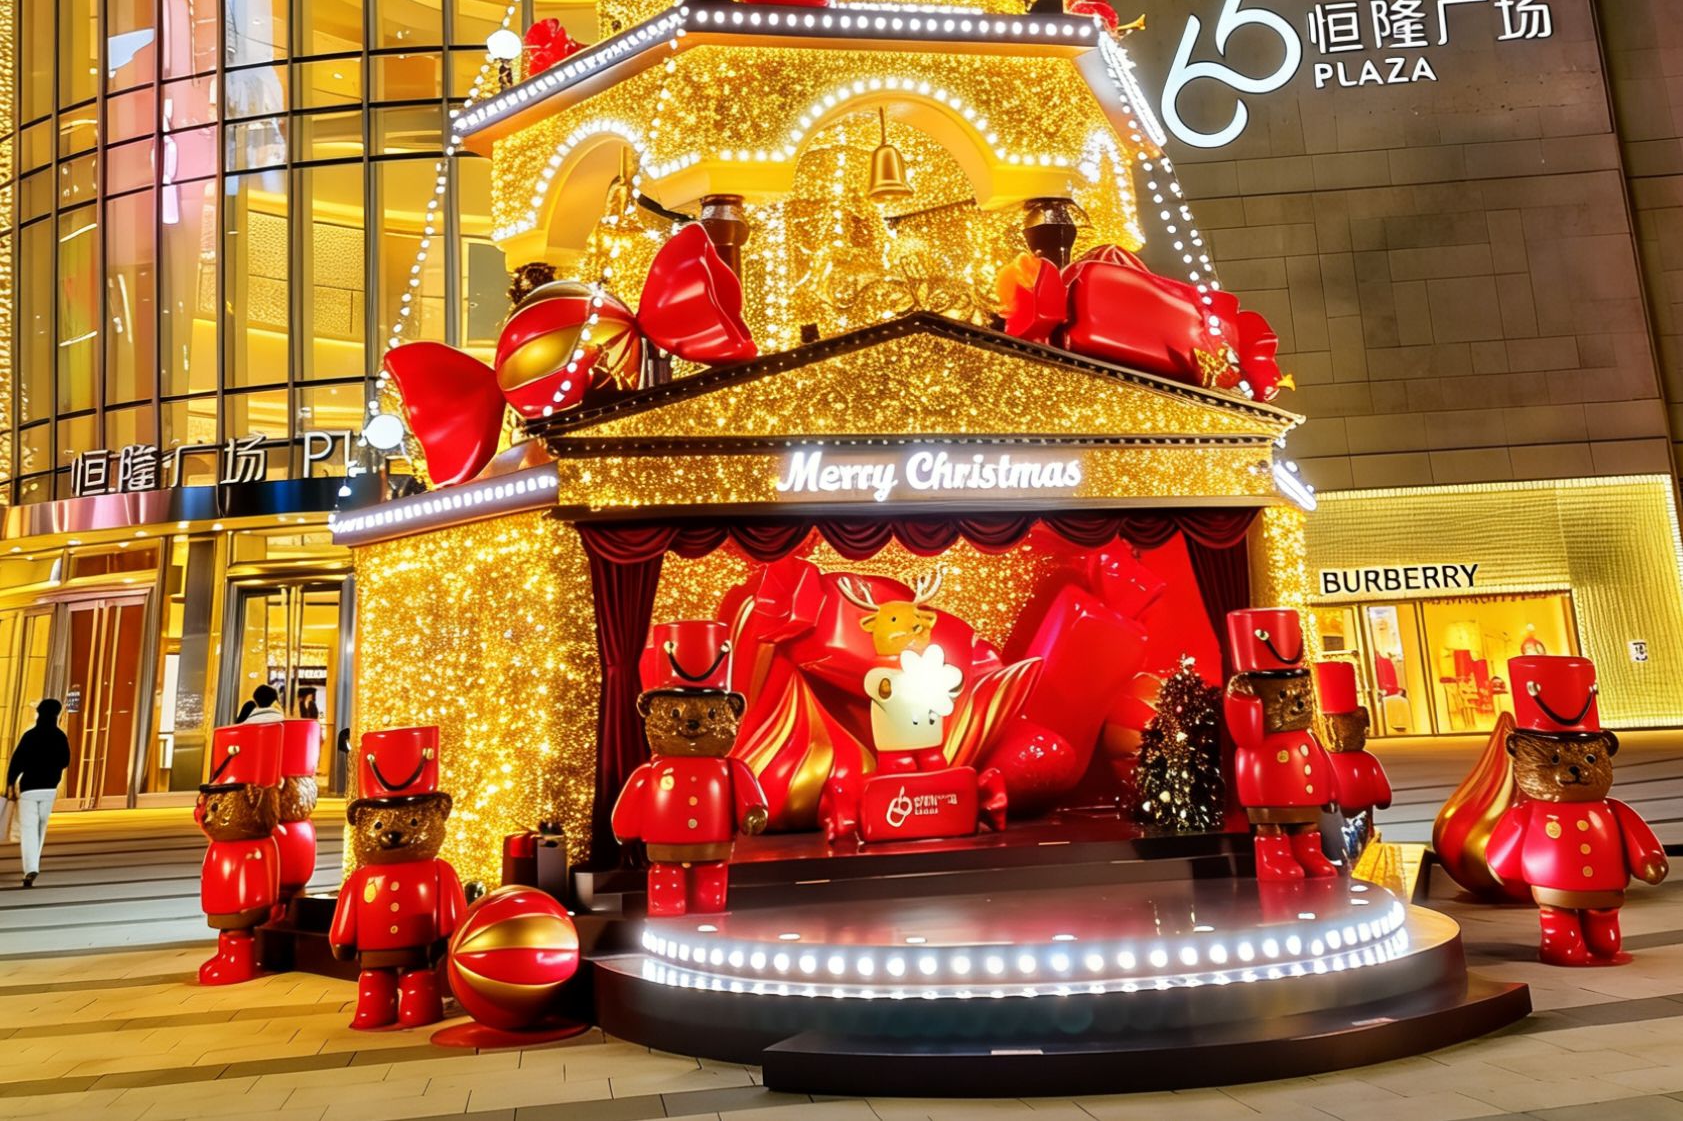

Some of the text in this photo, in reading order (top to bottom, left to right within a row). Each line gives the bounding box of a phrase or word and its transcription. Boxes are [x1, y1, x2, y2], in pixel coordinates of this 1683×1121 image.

[1313, 57, 1438, 88] PLAZA
[71, 432, 267, 497] 恒隆广场
[776, 451, 1081, 502] Merry Christmas
[1322, 564, 1478, 594] BURBERRY
